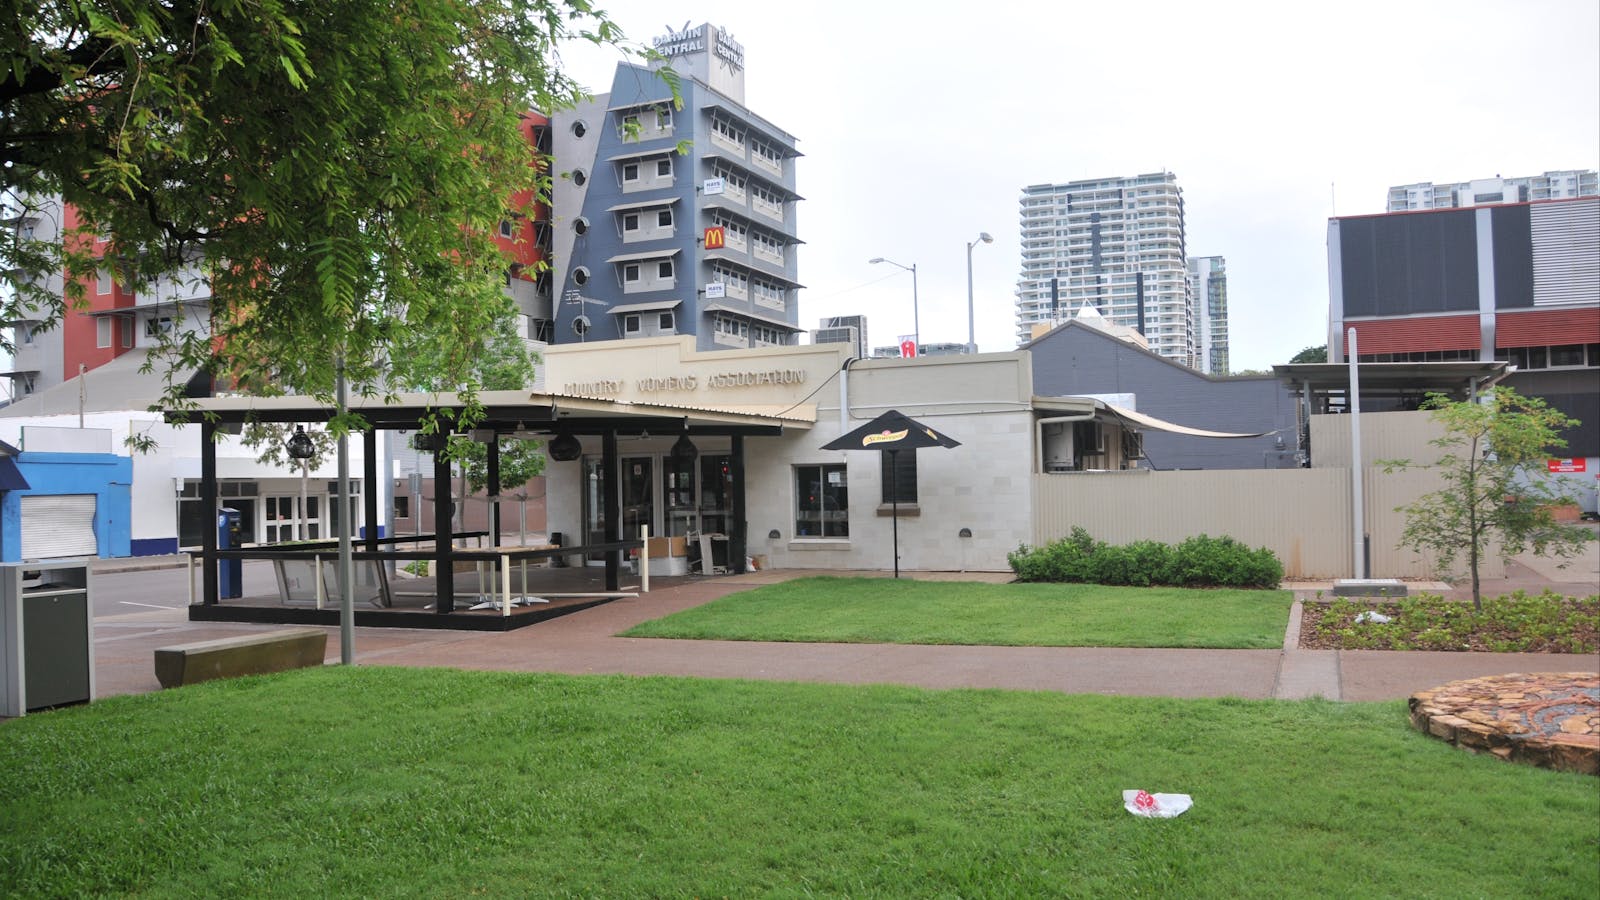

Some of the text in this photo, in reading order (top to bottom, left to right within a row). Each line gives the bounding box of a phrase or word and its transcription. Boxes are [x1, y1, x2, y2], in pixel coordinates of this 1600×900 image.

[652, 28, 702, 47] DARWIN
[657, 40, 704, 57] ENTRAL
[718, 31, 745, 56] DARWIN
[717, 44, 745, 68] CENTRAL
[636, 375, 697, 393] WOMENS
[706, 368, 806, 392] ASSOCIATION
